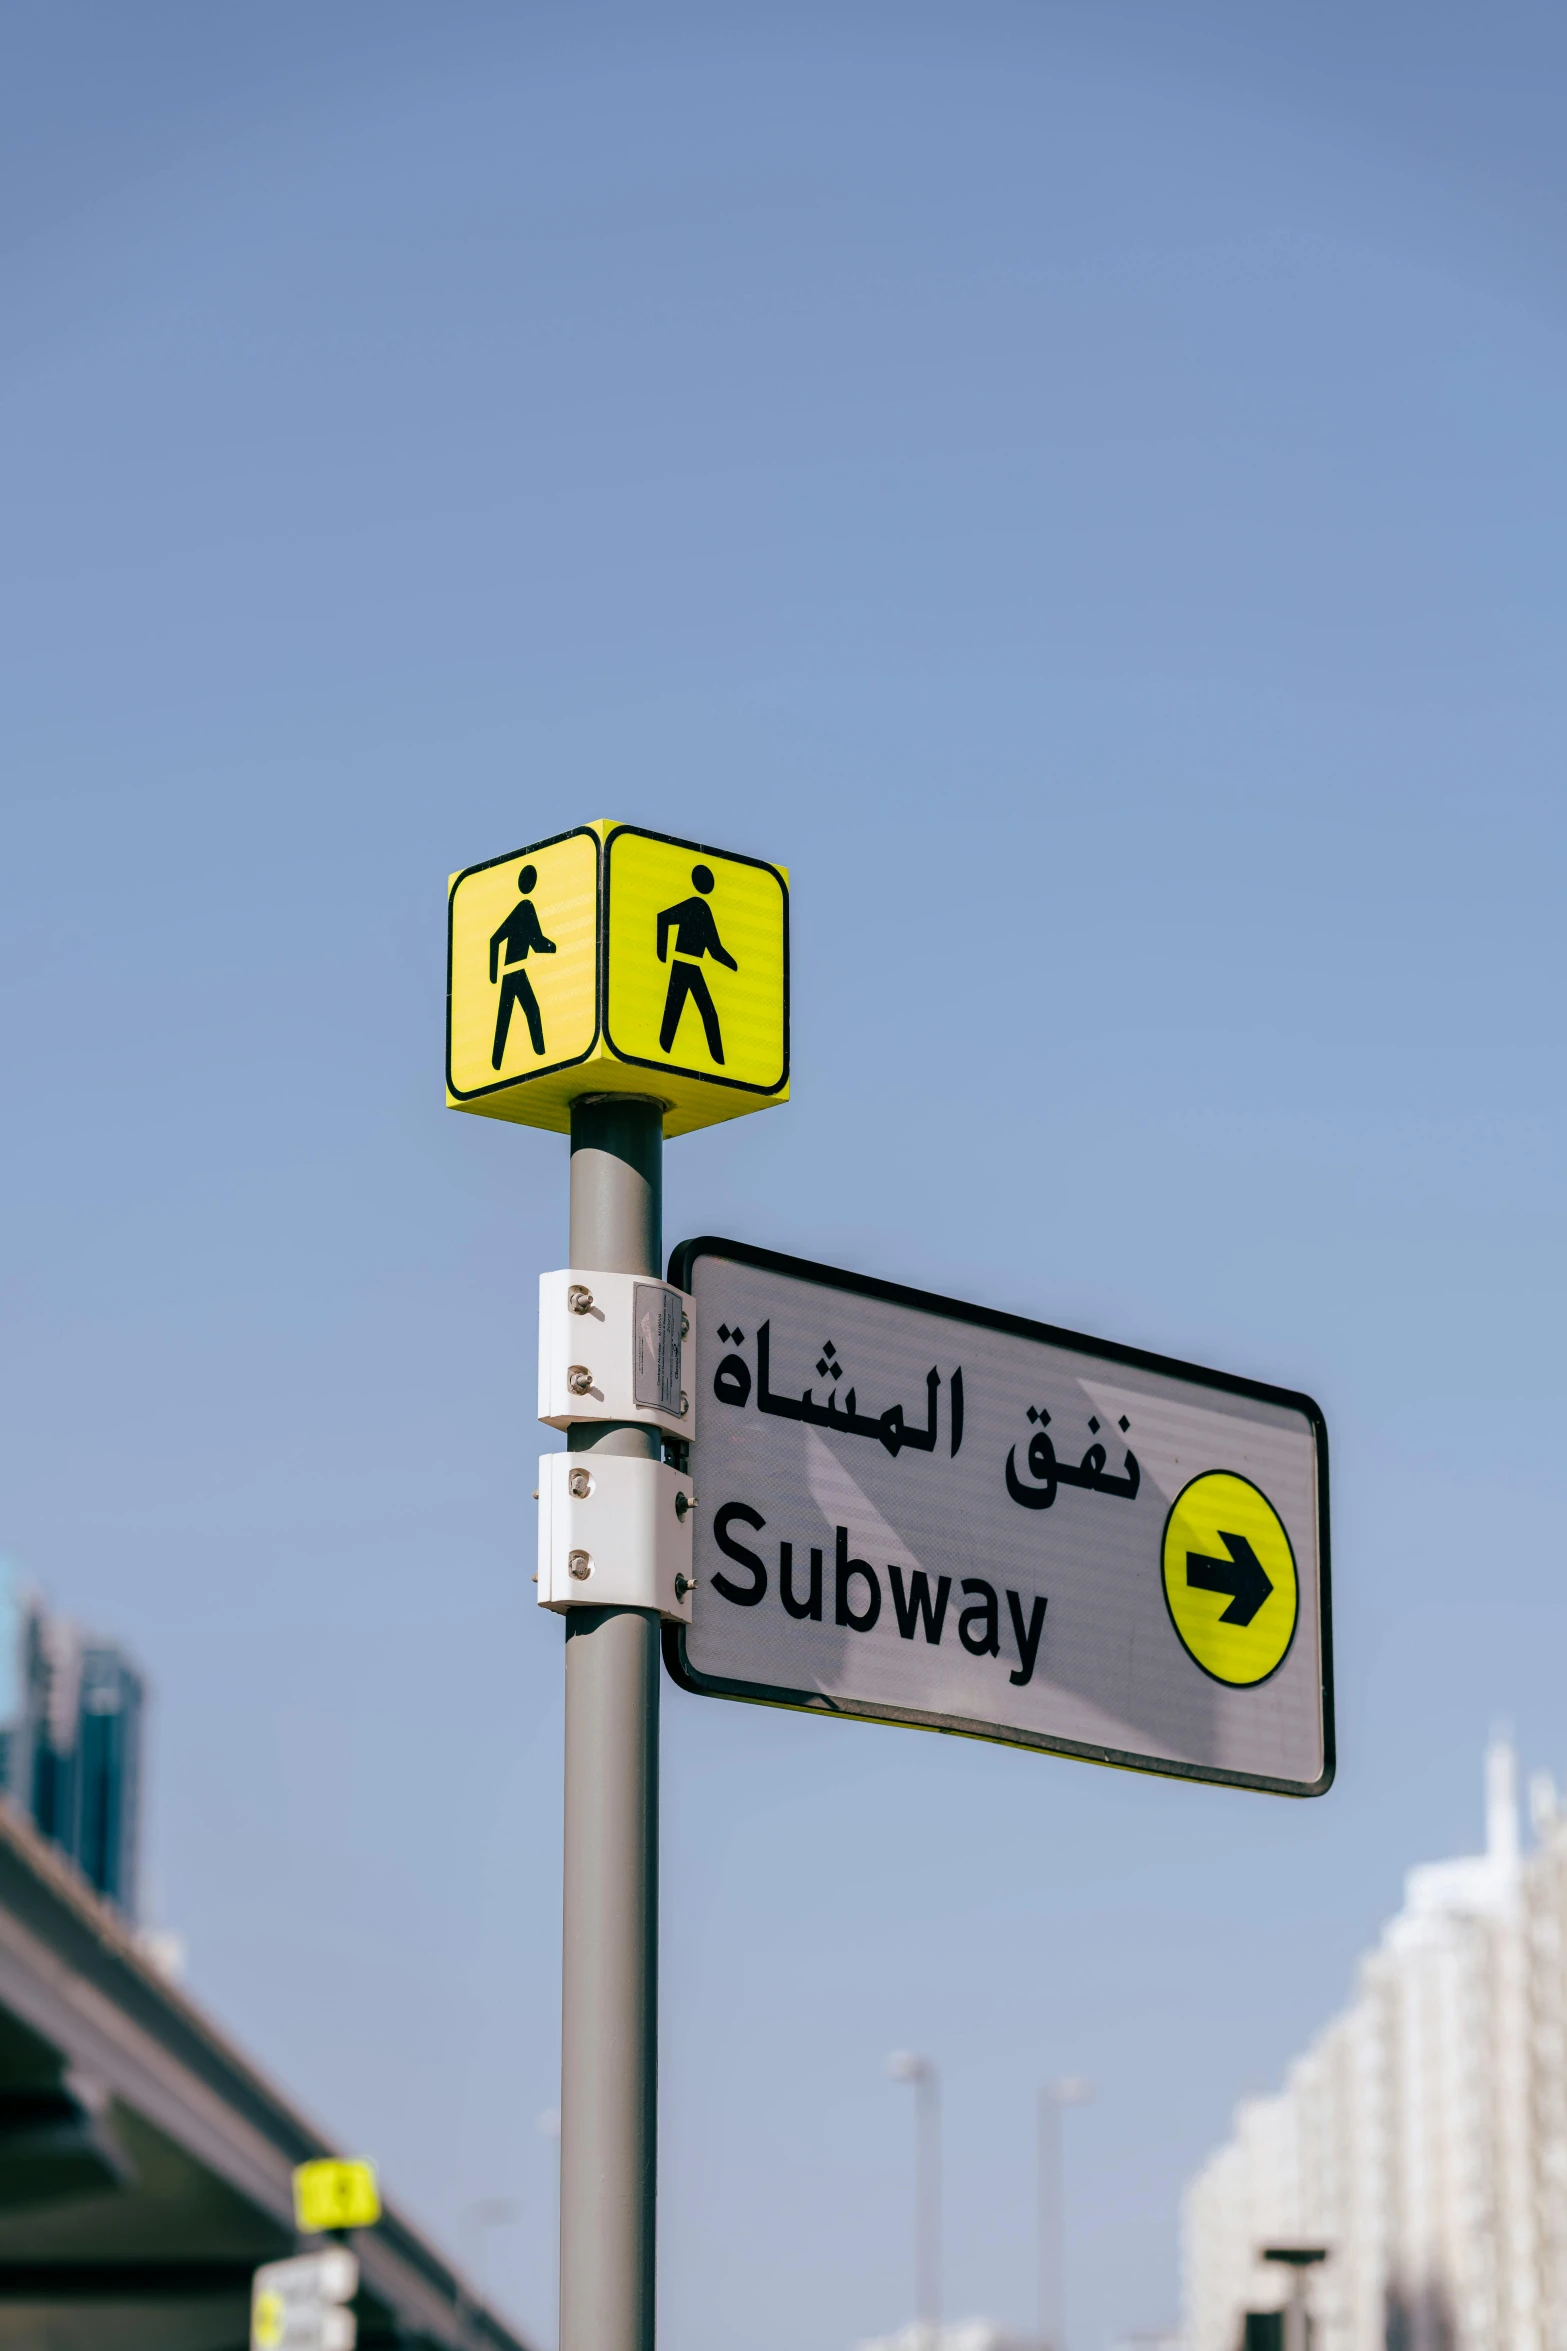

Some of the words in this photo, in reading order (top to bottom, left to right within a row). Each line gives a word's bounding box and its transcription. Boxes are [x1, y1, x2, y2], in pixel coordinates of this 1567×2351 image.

[713, 1319, 965, 1459] المشاة
[1005, 1405, 1141, 1511] نفق
[709, 1501, 1049, 1687] Subway
